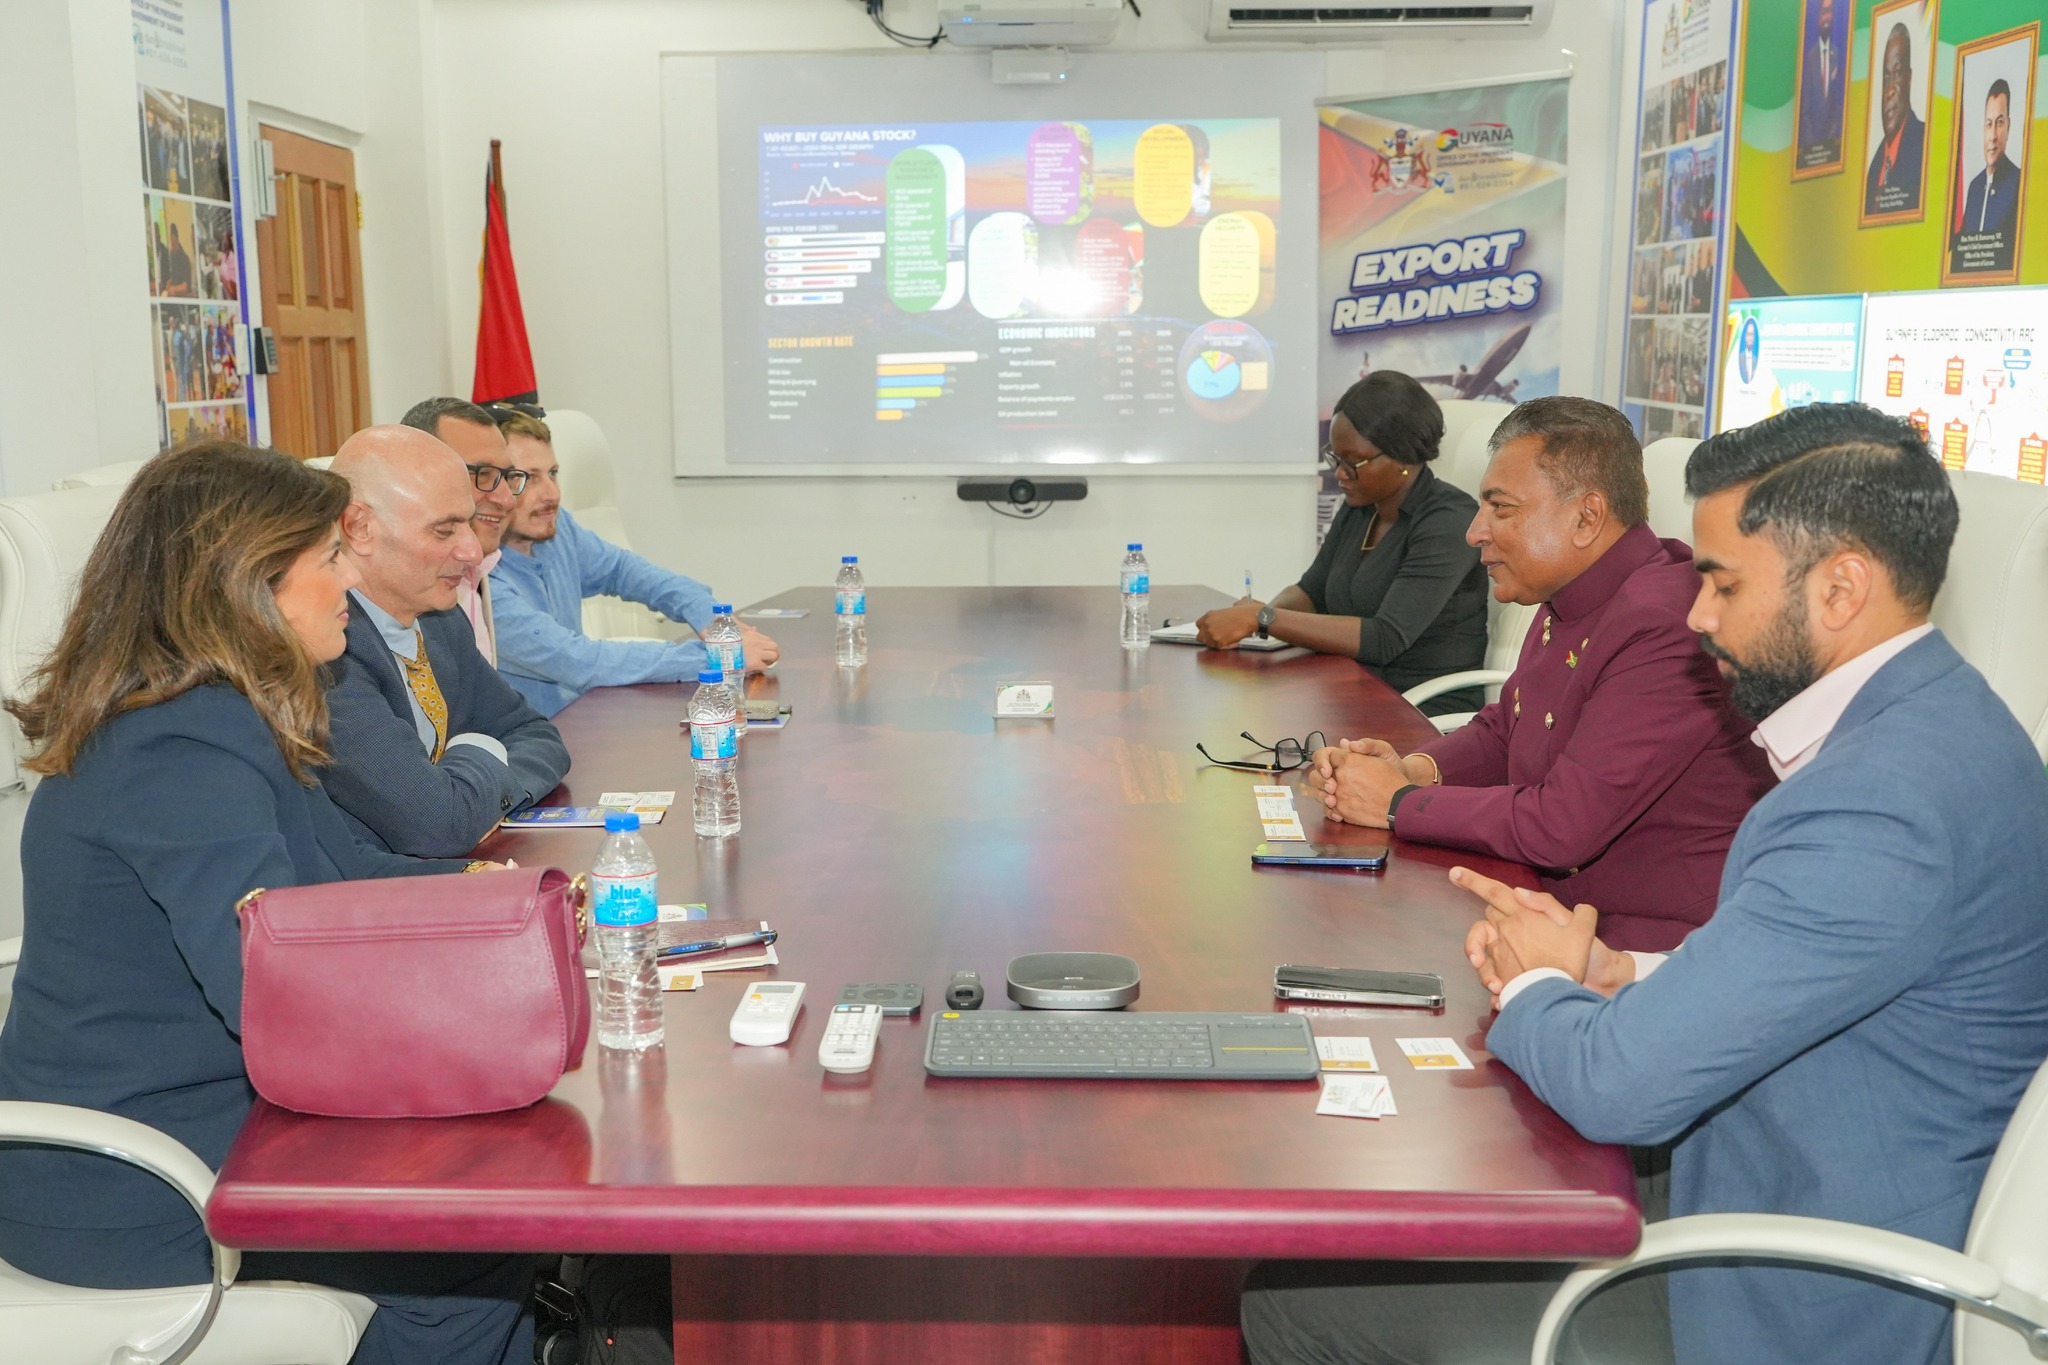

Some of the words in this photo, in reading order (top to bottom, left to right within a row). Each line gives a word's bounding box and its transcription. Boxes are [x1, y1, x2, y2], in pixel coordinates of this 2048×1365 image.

[764, 132, 792, 143] WHY
[795, 132, 818, 142] BUY
[820, 131, 870, 142] GUYANA
[873, 130, 916, 141] STOCK?
[1435, 127, 1514, 153] GUYANA
[1351, 230, 1525, 291] EXPORT
[1332, 271, 1541, 334] READINESS
[998, 328, 1043, 340] ECONOMIC
[1044, 326, 1096, 339] INDICATORS
[768, 337, 798, 348] SECTOR
[800, 336, 832, 348] GROWTH
[834, 336, 854, 347] RATE
[610, 884, 641, 900] blue
